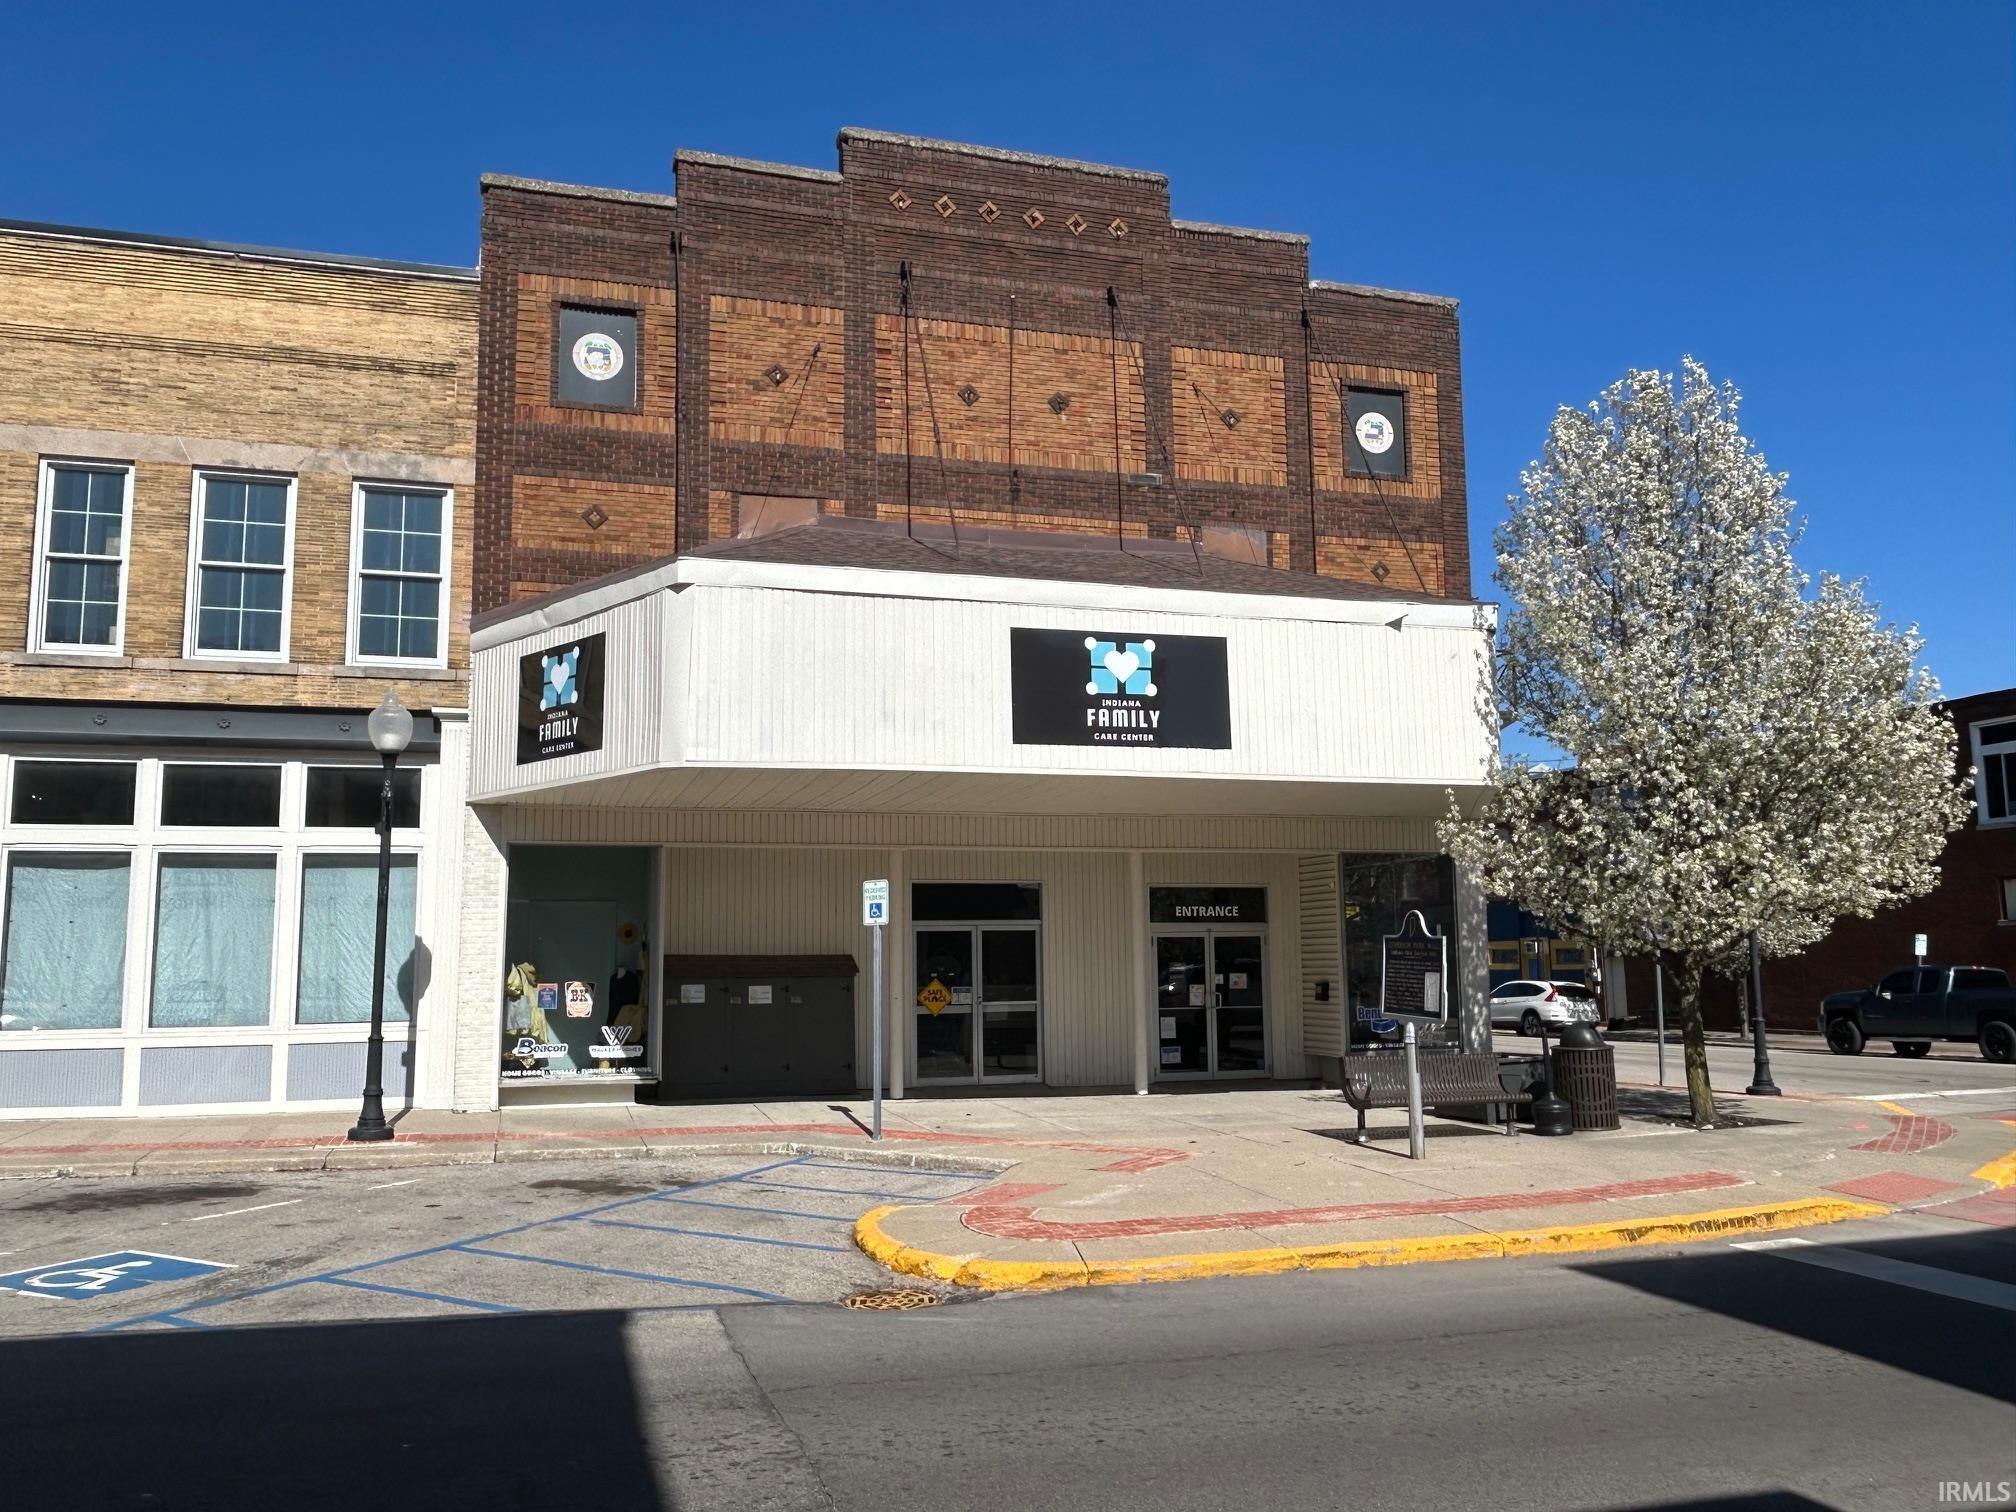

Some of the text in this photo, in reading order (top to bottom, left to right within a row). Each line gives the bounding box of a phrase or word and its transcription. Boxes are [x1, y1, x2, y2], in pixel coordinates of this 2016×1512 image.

[1102, 699, 1141, 707] INDIANA
[1087, 708, 1160, 728] FAMILY
[539, 717, 579, 742] FAMILY
[1094, 733, 1154, 742] CARE CENTER
[1175, 905, 1239, 917] ENTRANCE
[516, 1038, 567, 1055] Beacon
